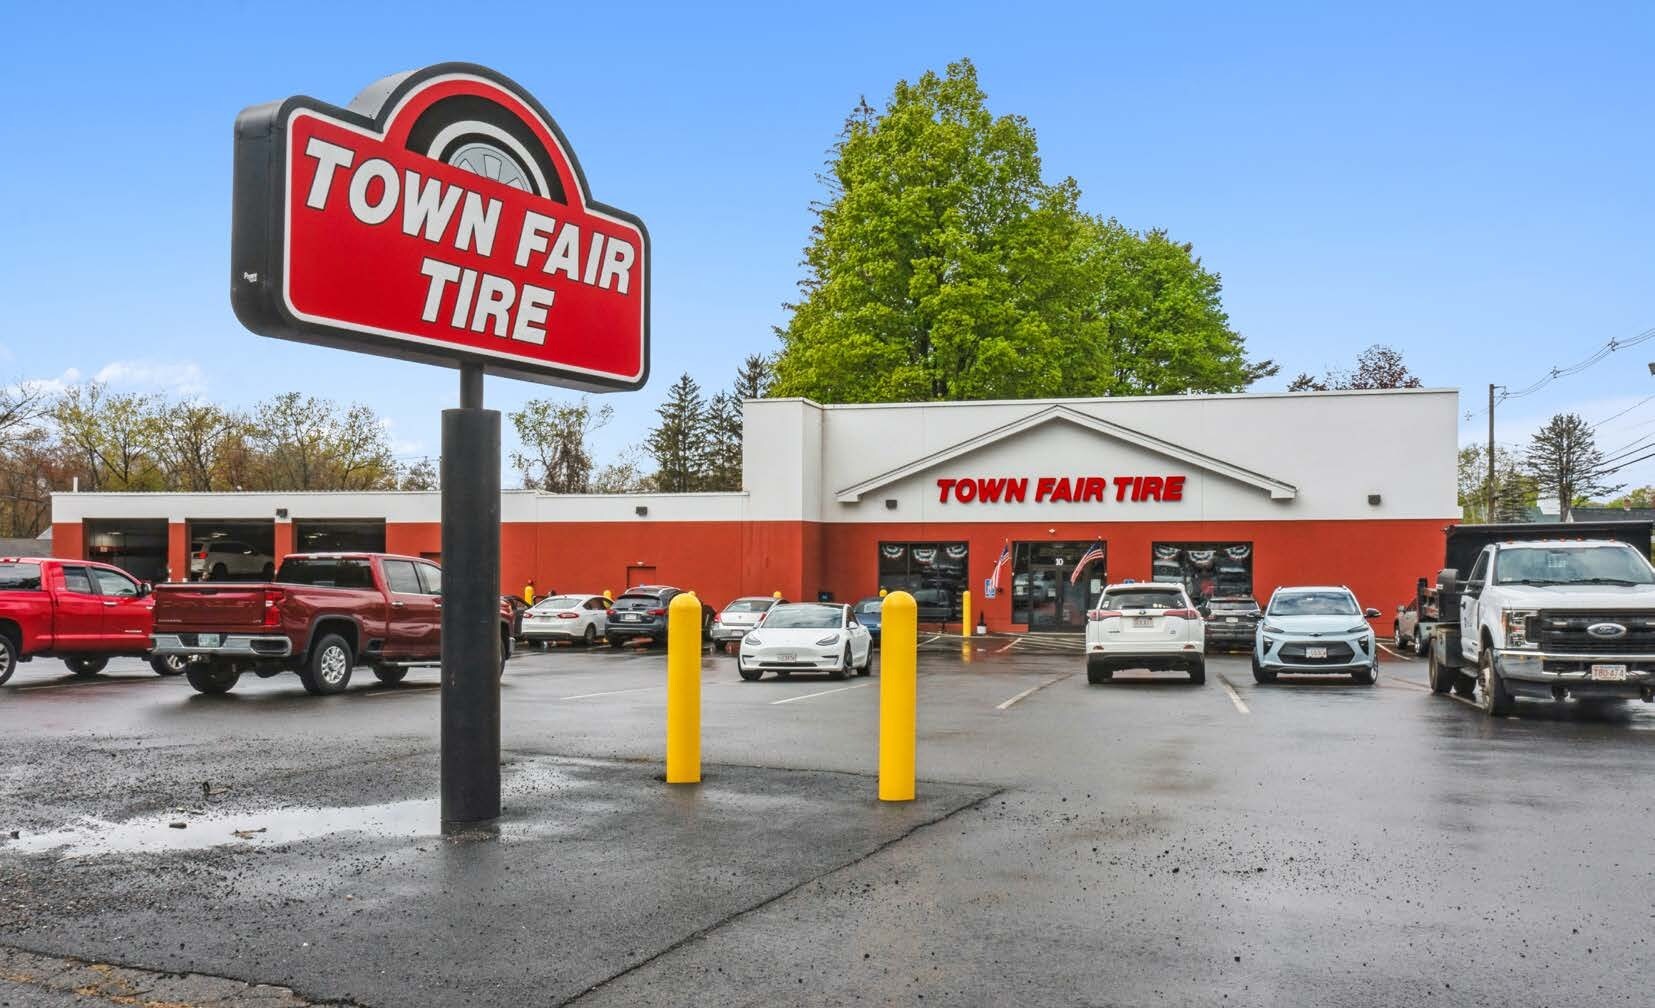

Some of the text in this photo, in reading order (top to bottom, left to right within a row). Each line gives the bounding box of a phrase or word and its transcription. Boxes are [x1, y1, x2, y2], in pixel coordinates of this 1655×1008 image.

[306, 137, 635, 294] TOWN FAIR
[421, 257, 555, 345] TIRE
[937, 476, 1186, 504] TOWN FAIR TIRE
[1055, 558, 1064, 566] 10
